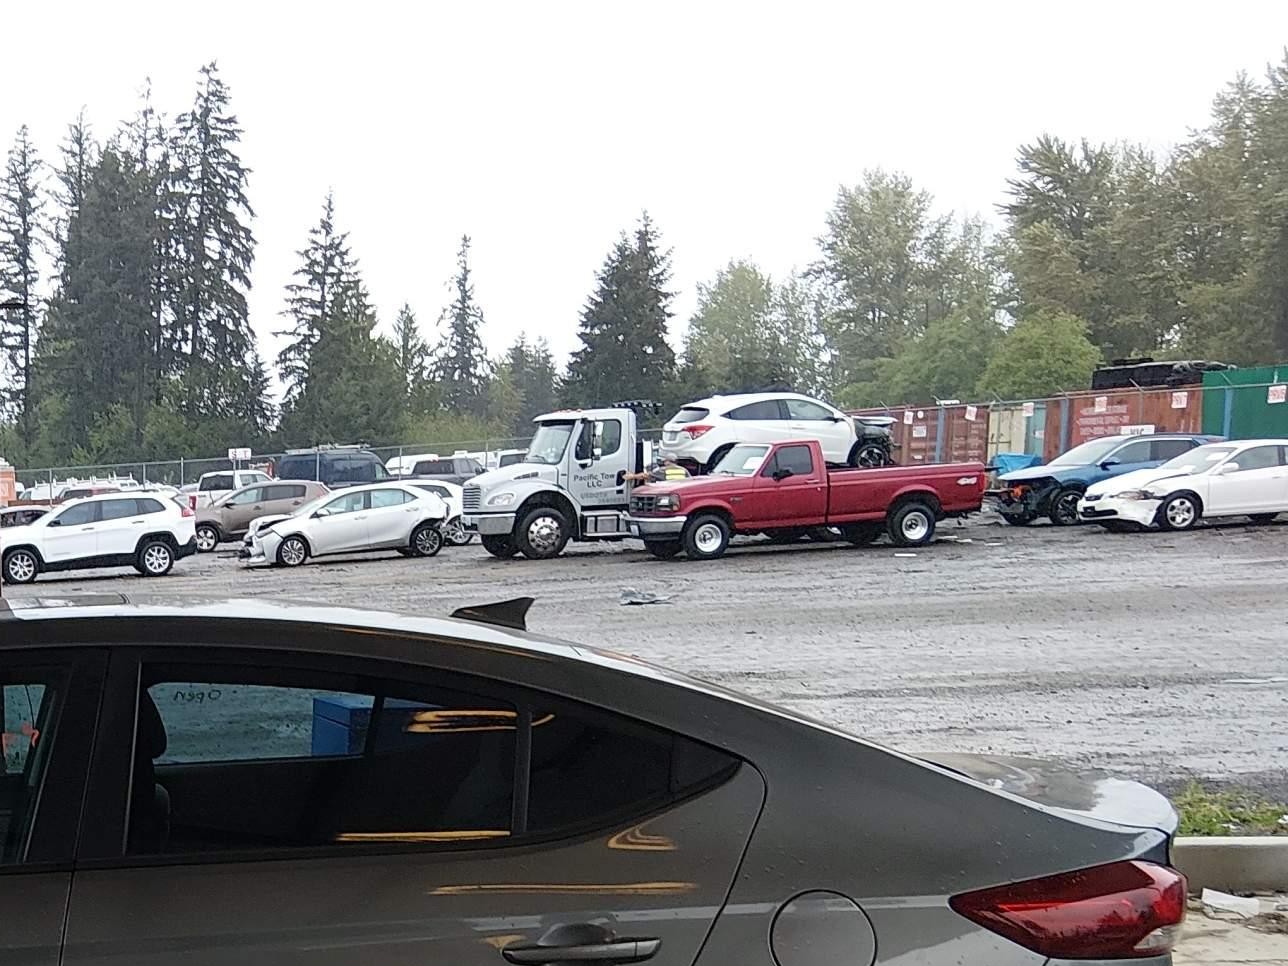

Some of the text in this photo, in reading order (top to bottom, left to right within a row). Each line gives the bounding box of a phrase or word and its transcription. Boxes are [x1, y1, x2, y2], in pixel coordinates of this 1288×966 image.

[573, 472, 616, 481] Pacific Tow
[586, 480, 603, 488] LLC
